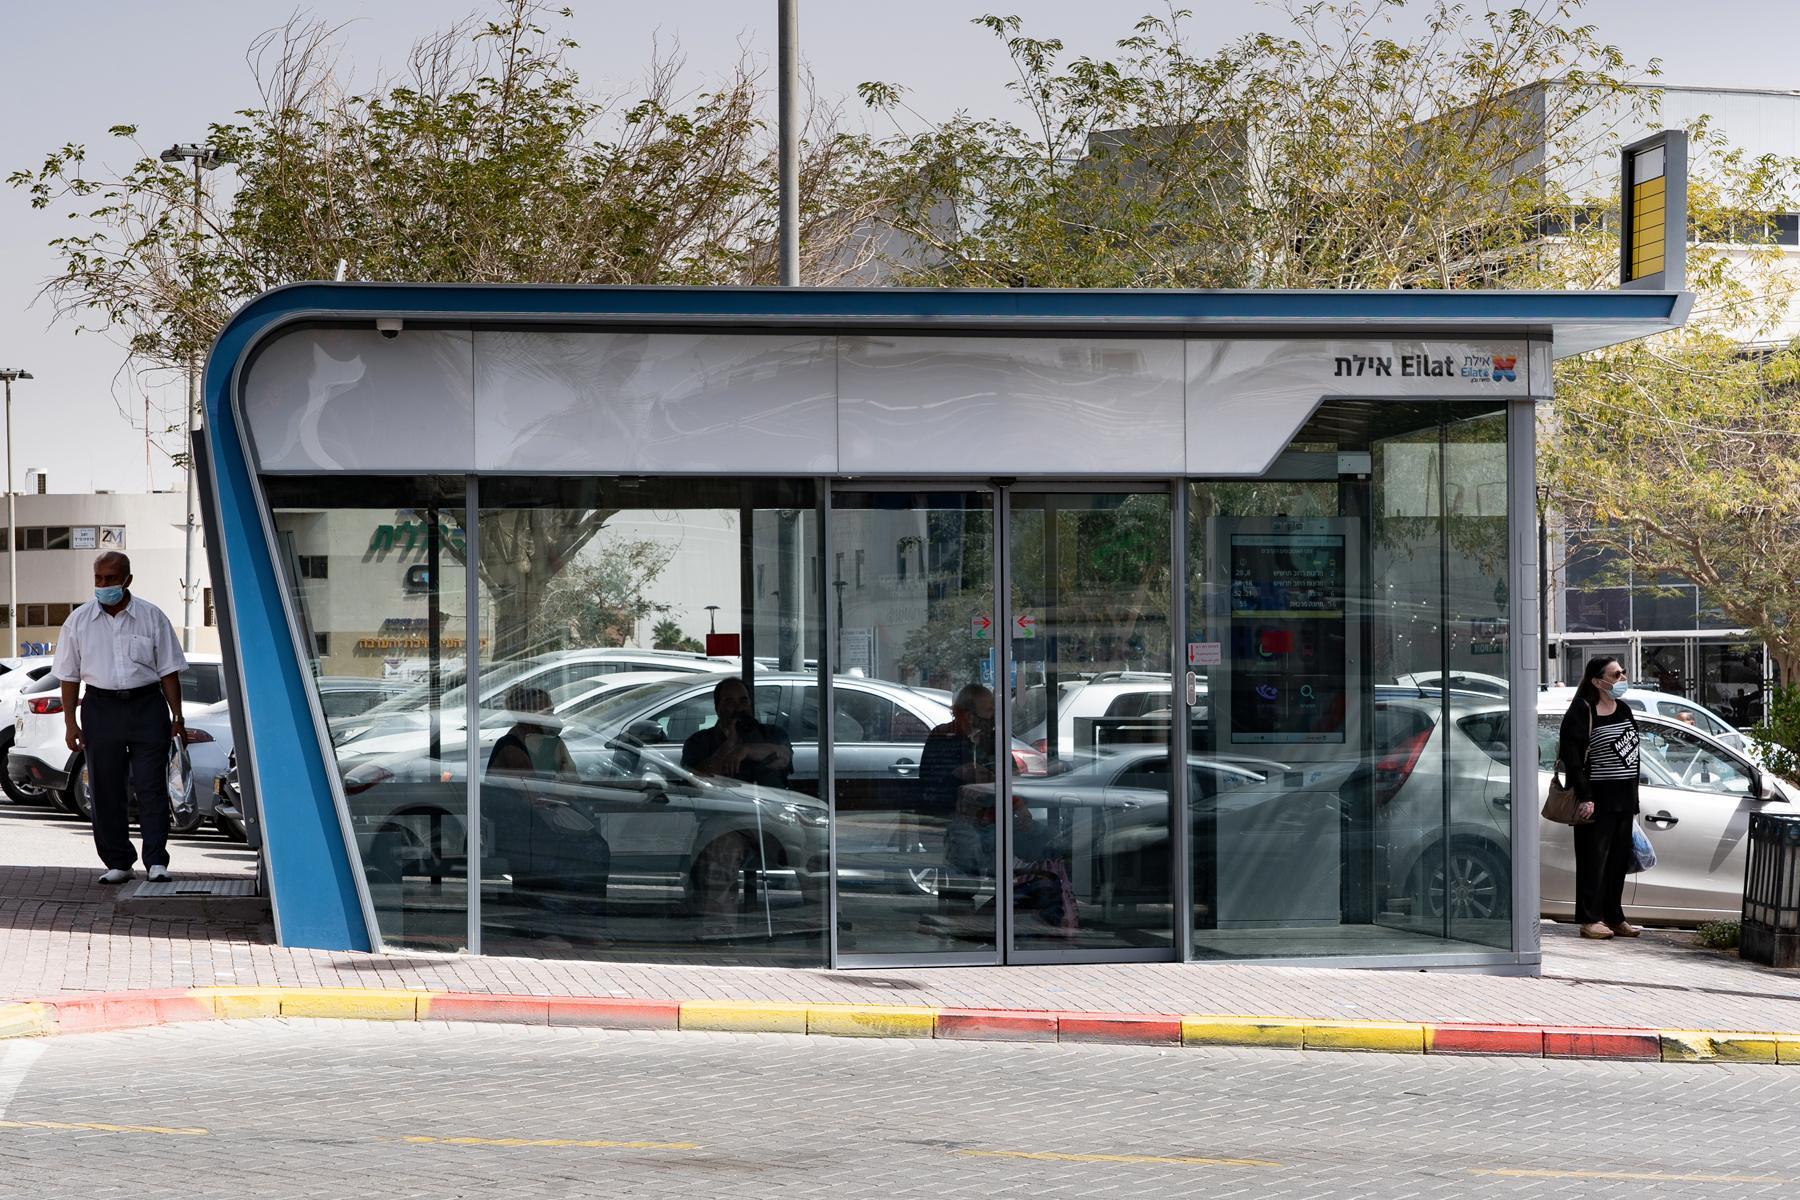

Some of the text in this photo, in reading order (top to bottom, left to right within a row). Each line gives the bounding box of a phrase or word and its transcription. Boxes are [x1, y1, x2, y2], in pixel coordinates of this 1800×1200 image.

[1334, 354, 1392, 377] אילת
[1401, 354, 1454, 377] Eilat
[1464, 355, 1490, 366] אילת
[102, 529, 123, 545] ZM
